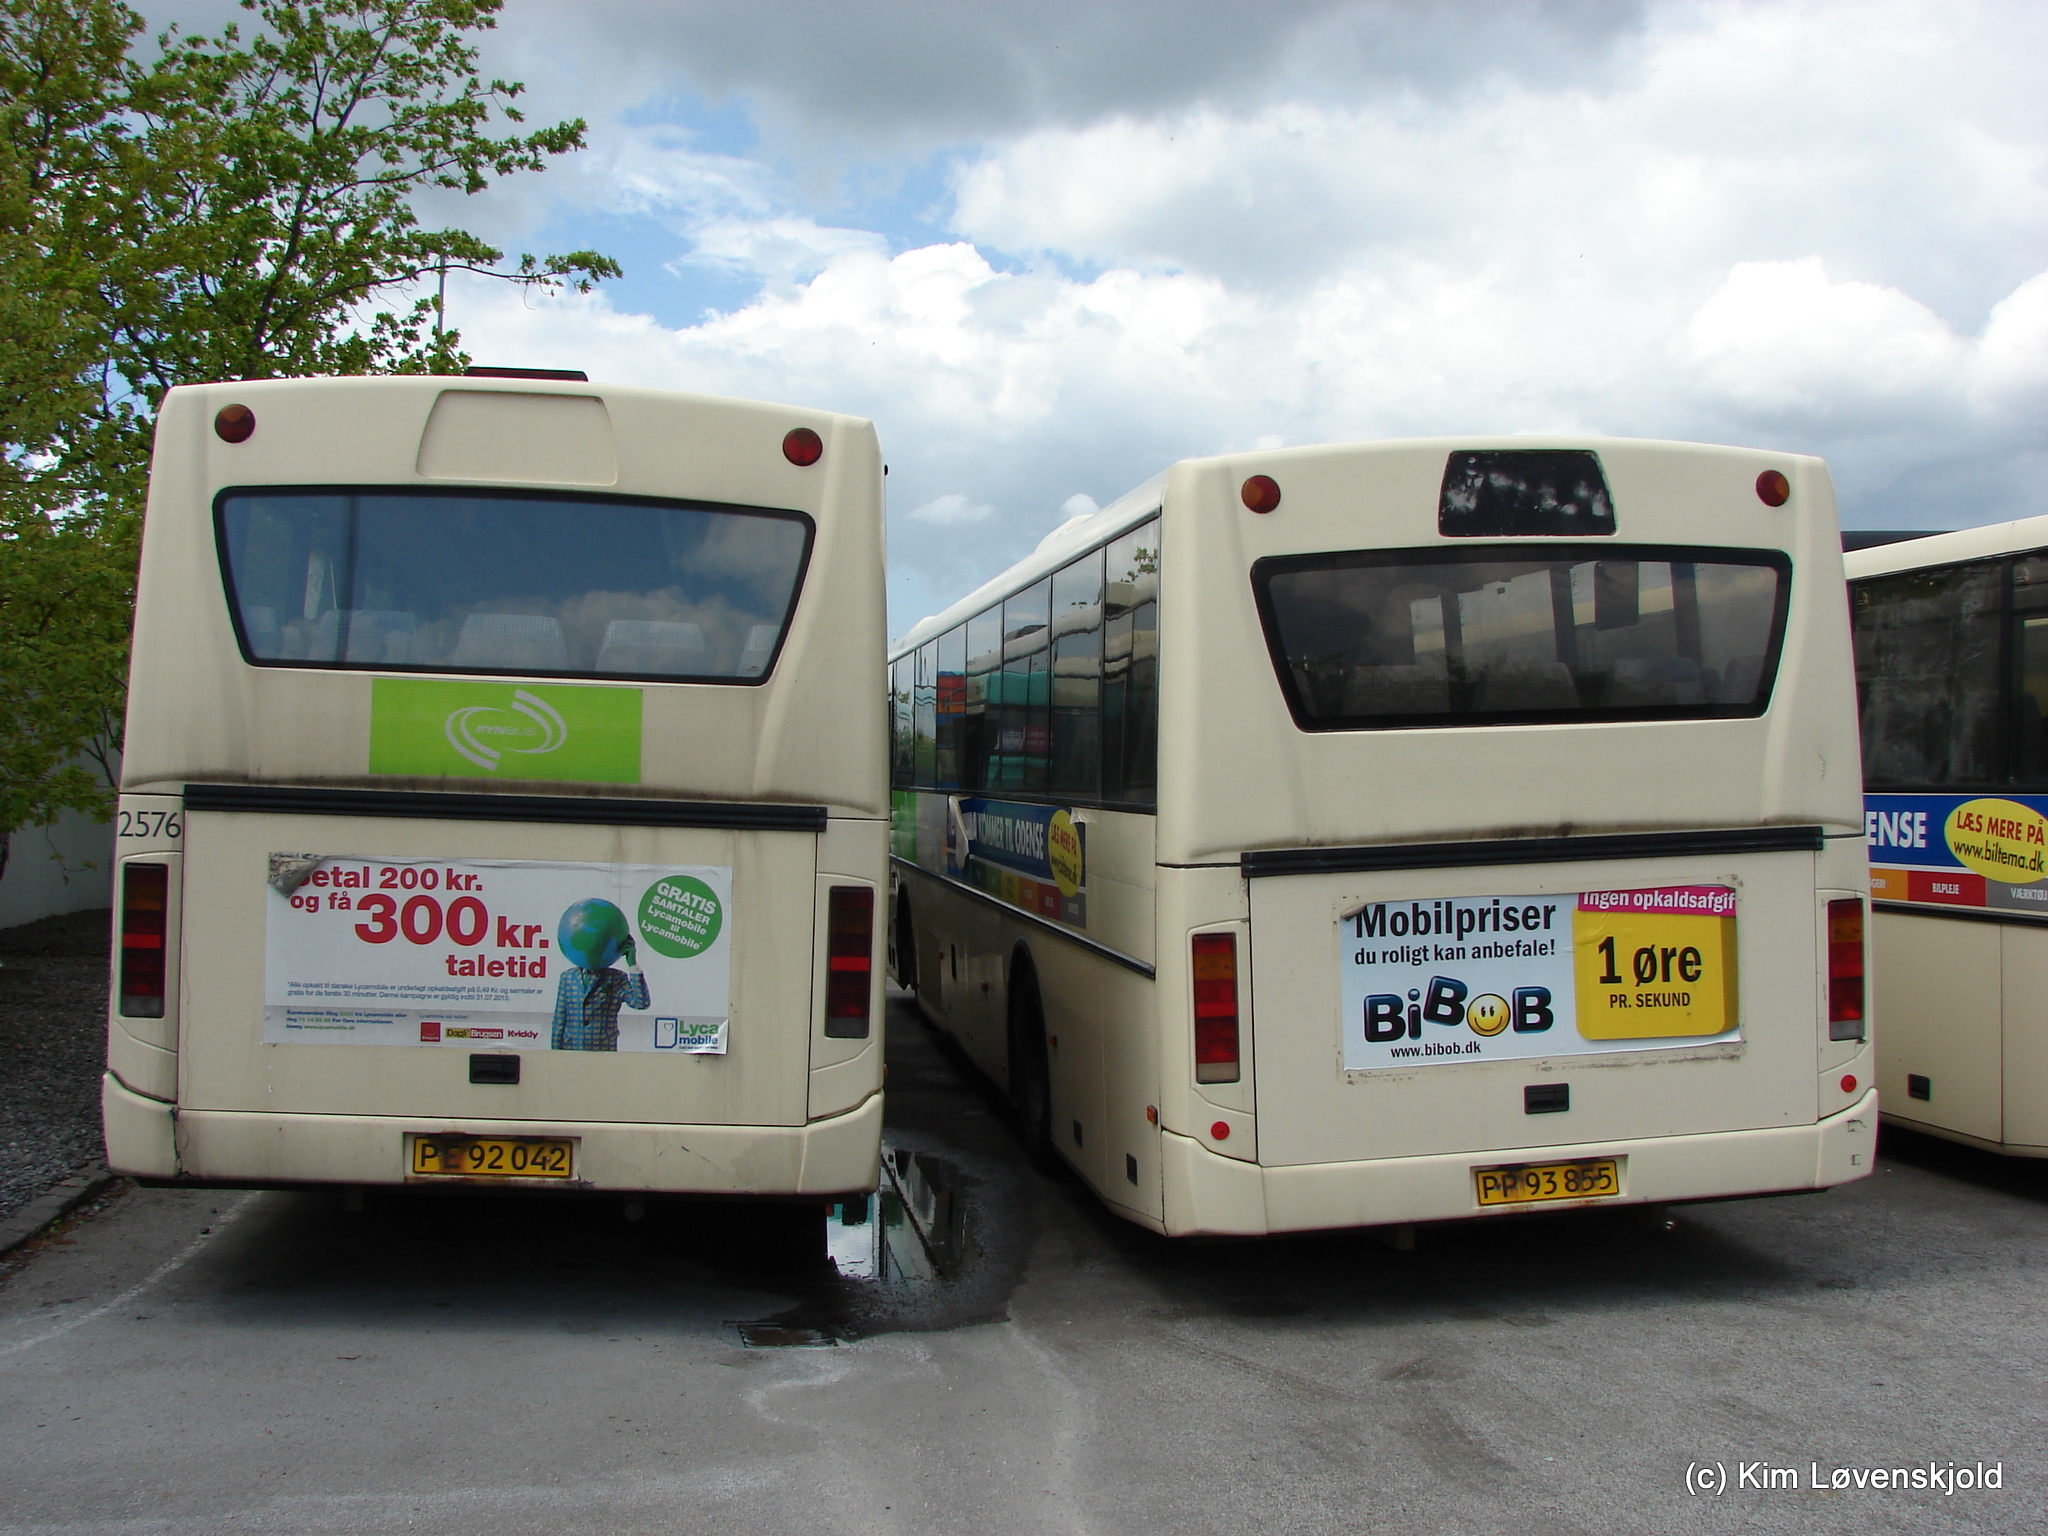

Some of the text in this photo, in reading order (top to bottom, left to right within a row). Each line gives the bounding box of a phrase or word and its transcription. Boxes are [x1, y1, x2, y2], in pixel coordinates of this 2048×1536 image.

[119, 811, 181, 838] 2576
[1005, 818, 1014, 852] TIL
[1015, 819, 1044, 860] ODENSE
[1956, 811, 2045, 846] LÆS MERE PÅ
[1953, 840, 2045, 873] www.biltema.dk
[379, 867, 439, 890] 200
[446, 868, 483, 891] kr.
[651, 895, 711, 926] SAMTALER
[656, 881, 717, 916] GRATIS
[290, 890, 549, 948] og få 300 kr.
[647, 905, 707, 936] Lycamobile
[670, 923, 680, 933] til
[1355, 899, 1556, 941] Mobilpriser
[445, 954, 547, 979] taletid
[1355, 939, 1556, 966] du roligt kan anbefale!
[1598, 936, 1702, 987] 1 øre
[1609, 992, 1691, 1009] PR. SEKUND
[679, 1020, 719, 1037] Lyca
[679, 1035, 718, 1045] mobile
[1390, 1041, 1482, 1058] www.bibob.dk
[420, 1144, 566, 1172] PE 92 042
[1482, 1166, 1612, 1199] PP 93 855
